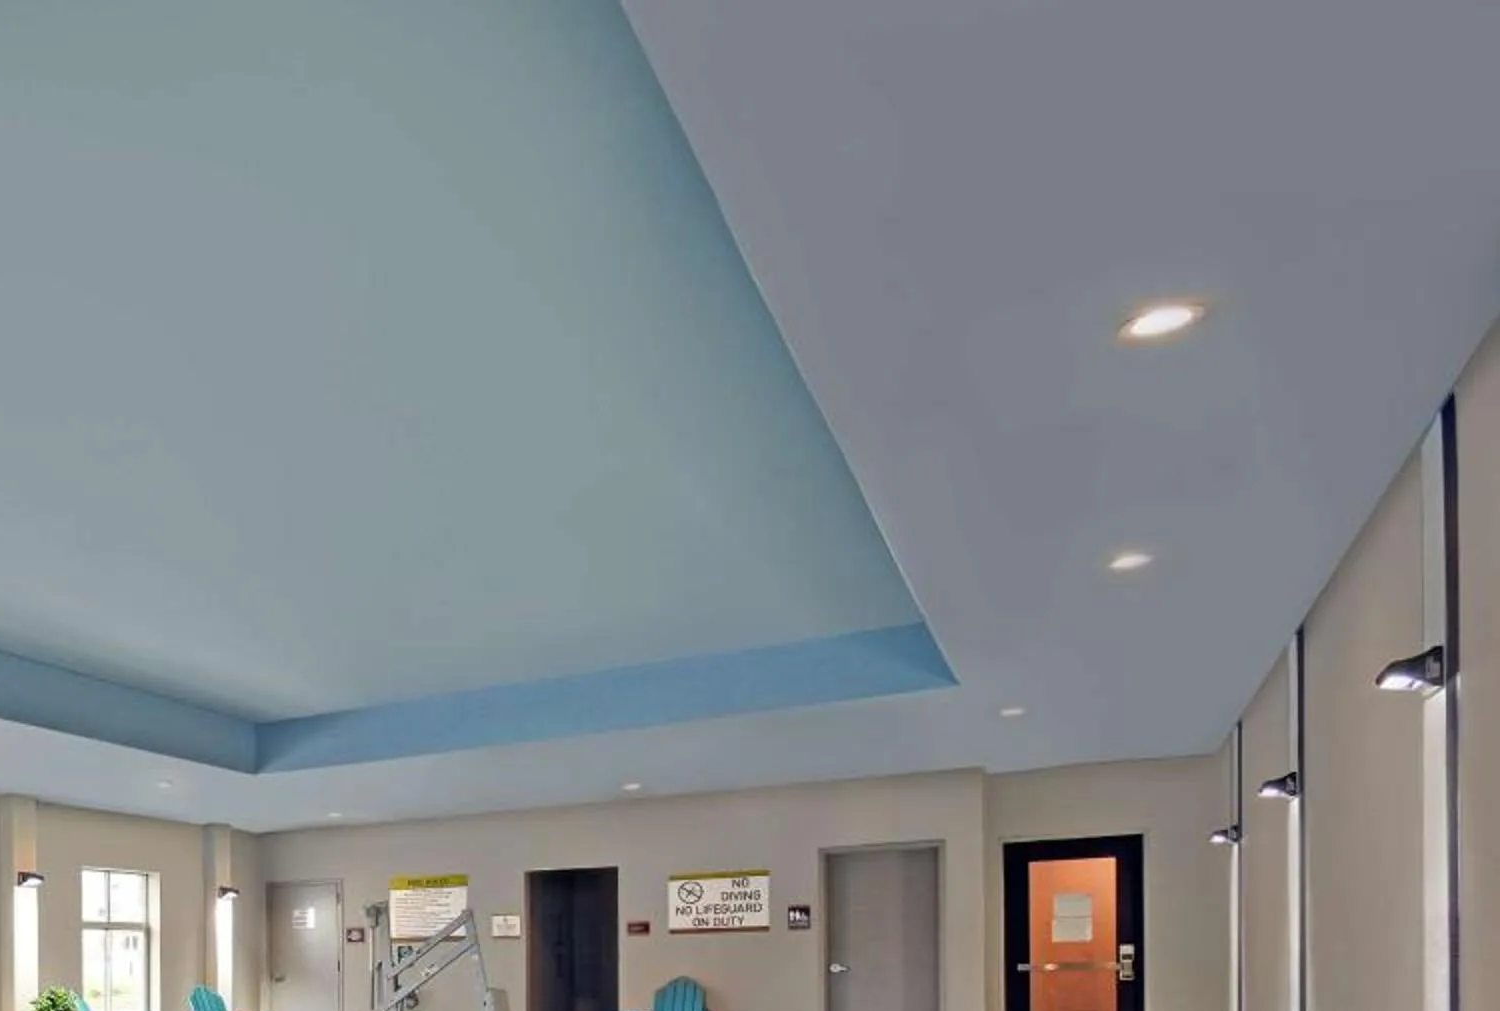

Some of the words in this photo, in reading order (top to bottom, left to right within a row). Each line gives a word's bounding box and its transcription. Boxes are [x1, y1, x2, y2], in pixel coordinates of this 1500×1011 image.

[731, 877, 750, 888] NO
[720, 890, 762, 901] DIVING
[675, 906, 693, 916] NO
[695, 903, 763, 915] LIFEGUARD
[692, 917, 709, 927] ON
[713, 915, 744, 926] DUTY
